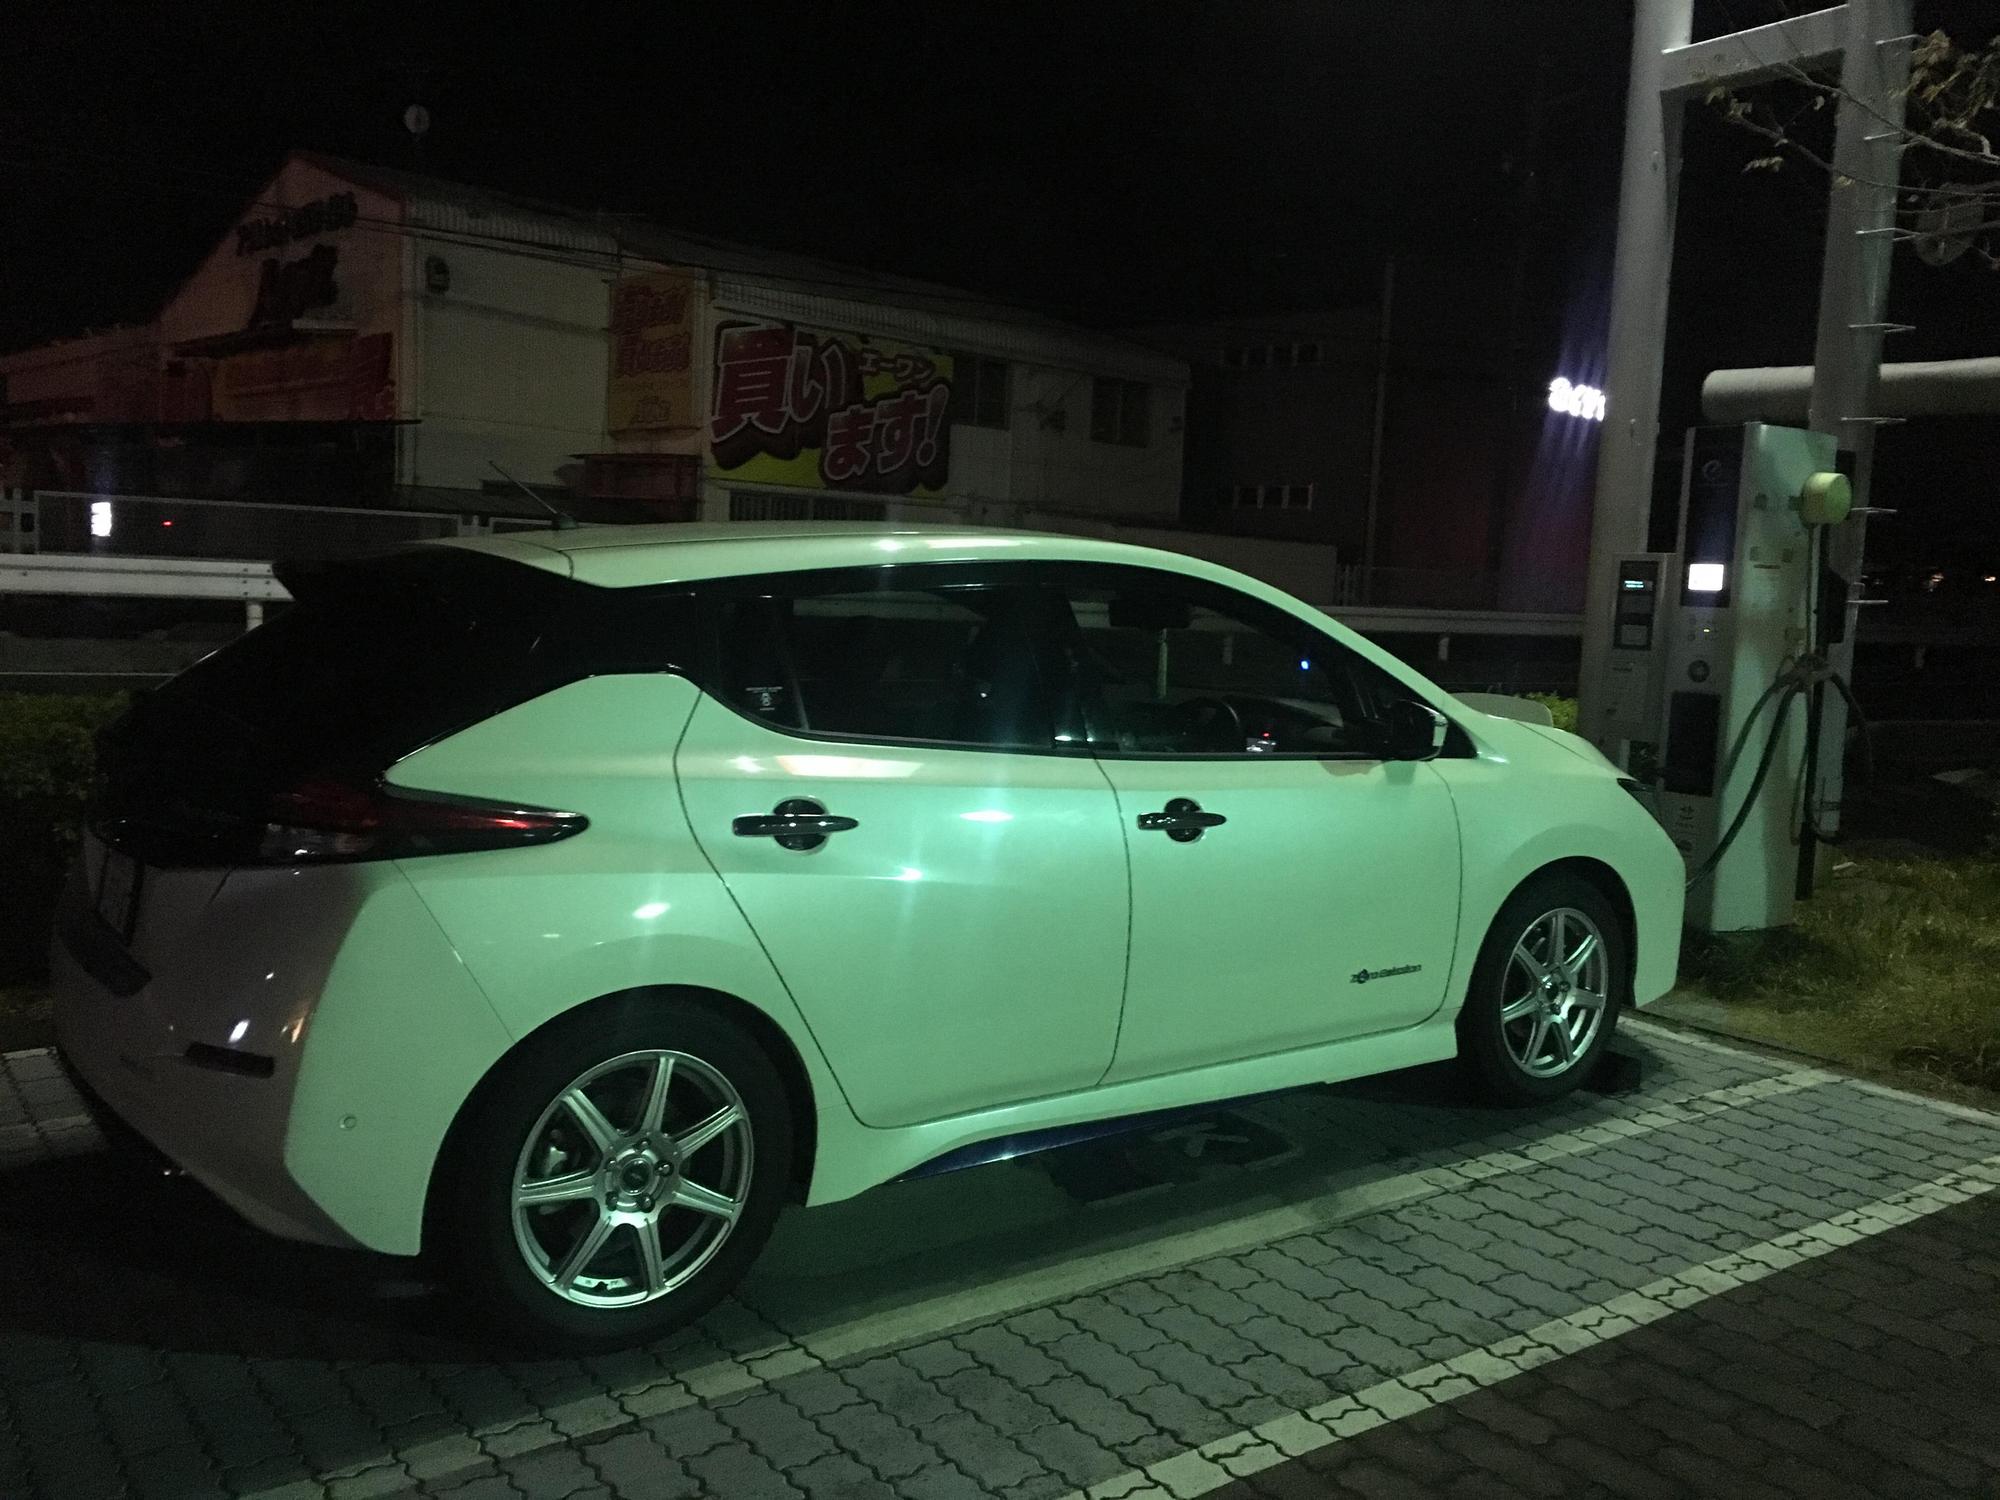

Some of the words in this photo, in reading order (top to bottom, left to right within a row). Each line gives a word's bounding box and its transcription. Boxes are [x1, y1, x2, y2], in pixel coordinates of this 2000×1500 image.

[711, 326, 846, 443] 買い
[859, 352, 934, 380] エーワン
